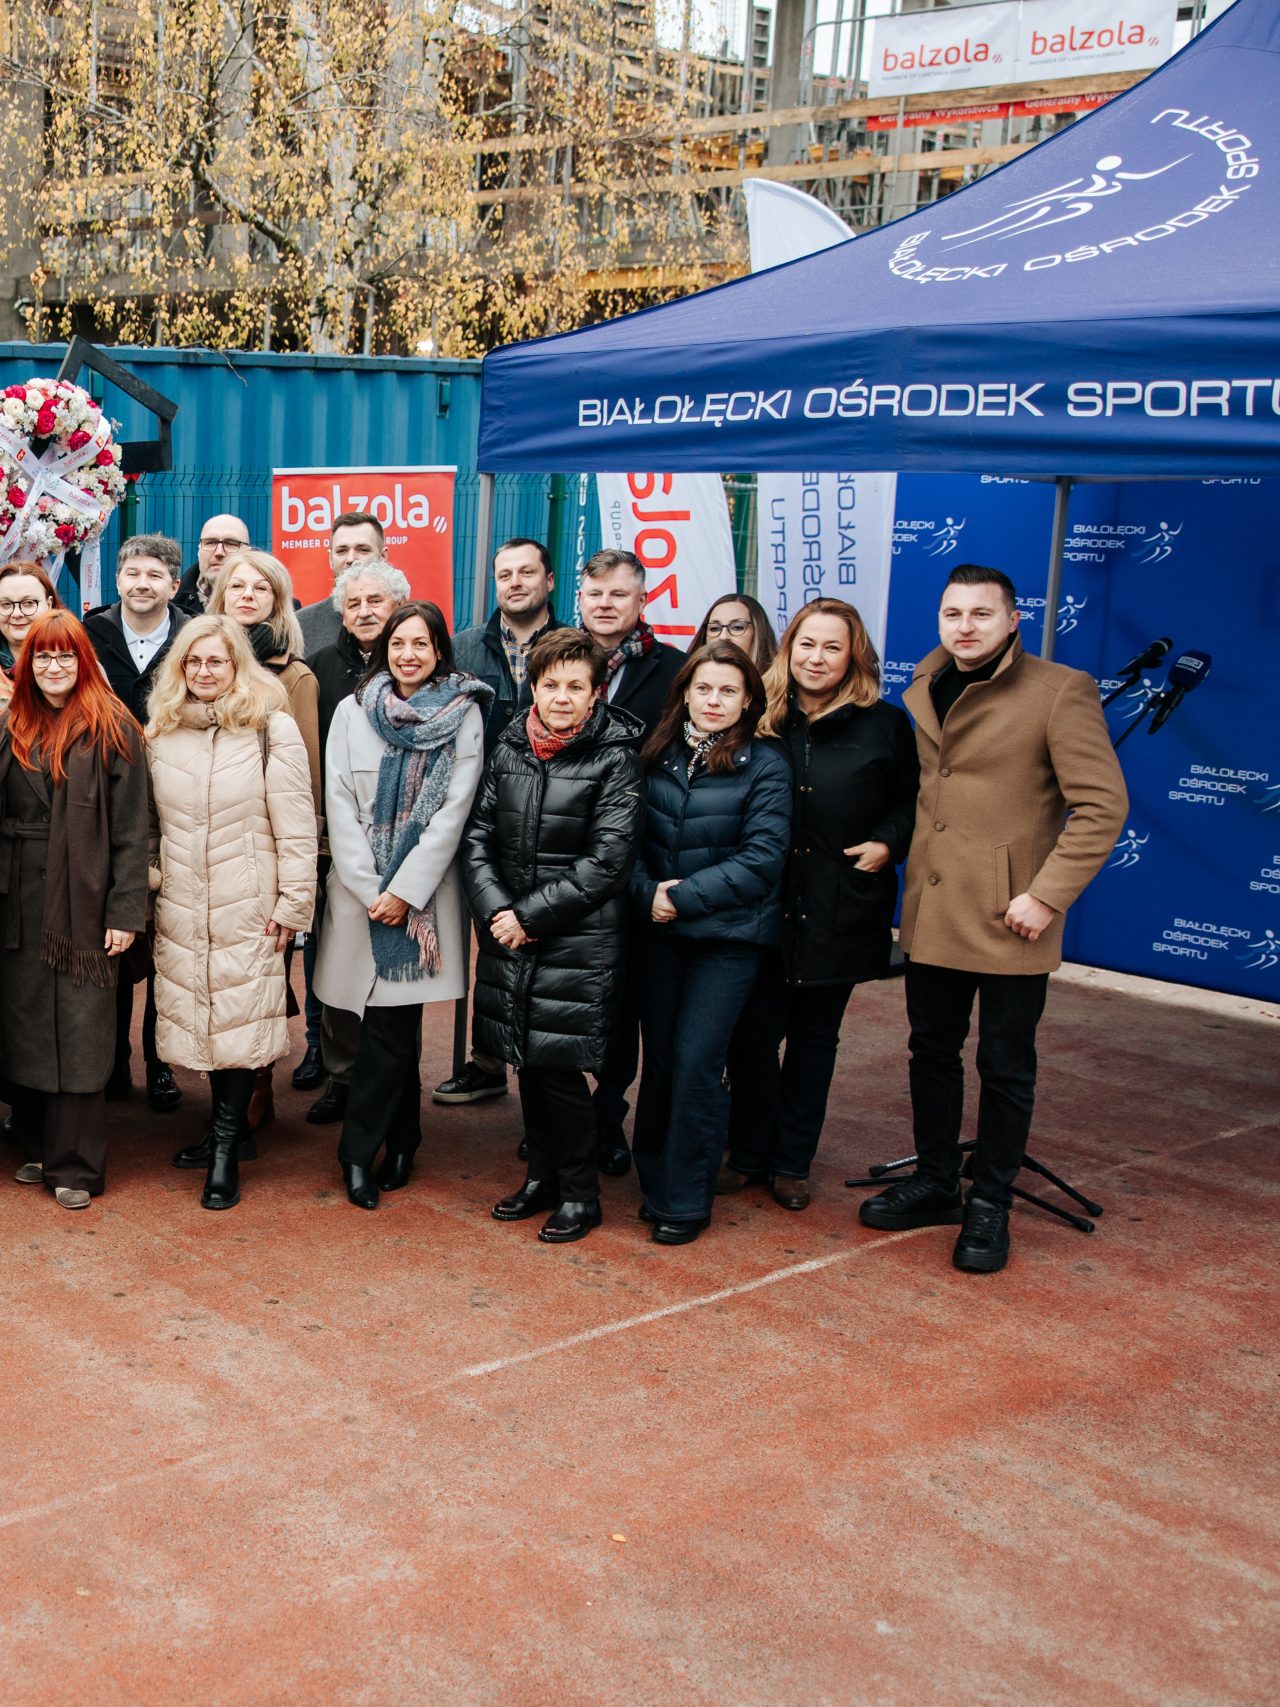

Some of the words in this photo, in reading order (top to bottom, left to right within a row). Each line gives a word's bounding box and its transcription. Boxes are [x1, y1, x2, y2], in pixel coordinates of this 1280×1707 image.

[1031, 20, 1145, 55] balzola
[883, 38, 989, 72] balzola
[888, 230, 1008, 284] BIAŁOŁĘCKI
[1024, 184, 1252, 271] OŚRODEK
[1150, 109, 1259, 180] SPORTU
[578, 391, 792, 427] BIAŁOŁĘCKI
[803, 378, 1045, 419] OŚRODEK
[281, 483, 430, 533] balzola
[1073, 524, 1146, 536] BIAŁOŁĘCKI
[281, 539, 321, 550] MEMBER
[323, 538, 330, 547] O
[385, 536, 408, 545] ROUP
[1063, 552, 1105, 562] PORTU
[1190, 764, 1269, 782] BIAŁOŁĘCKI
[1179, 777, 1247, 795] OŚRODEK
[1168, 790, 1225, 806] SPORTU
[1249, 881, 1280, 894] SPO
[1173, 917, 1251, 940] BIAŁOŁĘCKI
[1162, 929, 1230, 950] OŚRODEK
[1152, 942, 1208, 961] SPORTU
